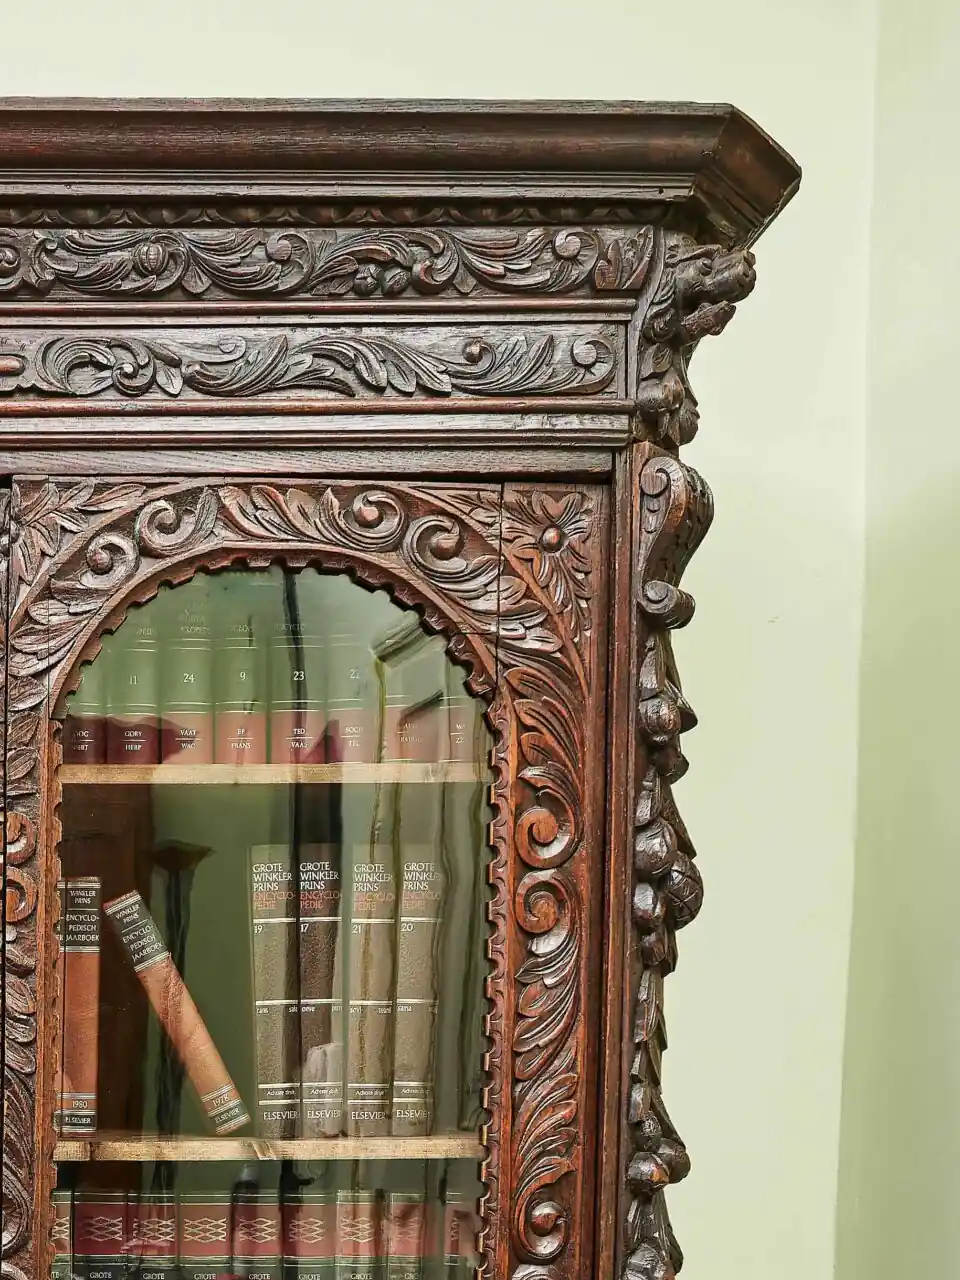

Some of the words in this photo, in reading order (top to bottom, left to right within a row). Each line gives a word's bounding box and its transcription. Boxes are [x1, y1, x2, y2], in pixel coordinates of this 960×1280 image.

[183, 673, 196, 683] 24
[293, 671, 305, 681] 23
[253, 863, 284, 873] GROTE
[300, 862, 330, 871] GROTE
[354, 863, 385, 873] GROTE
[404, 862, 436, 871] GROTE
[253, 872, 293, 882] WINKLER
[300, 871, 340, 880] WINKLER
[253, 882, 279, 892] PRINS
[300, 881, 325, 890] PRINS
[353, 882, 379, 892] PRINS
[403, 881, 429, 890] PRINS
[300, 900, 323, 909] PEDIE
[115, 903, 140, 920] WINKLER
[123, 911, 139, 924] PRINS
[253, 924, 263, 933] 19
[300, 924, 309, 933] 17
[352, 924, 361, 934] 21
[401, 923, 414, 932] 20
[122, 925, 154, 943] ENCYCLO-
[130, 934, 156, 952] PEDISCH
[131, 941, 164, 962] JAARBOEK
[72, 1100, 88, 1108] 1980
[263, 1110, 297, 1120] ELSEVIER
[307, 1109, 341, 1119] ELSEVIER
[351, 1111, 386, 1120] ELSEVIER
